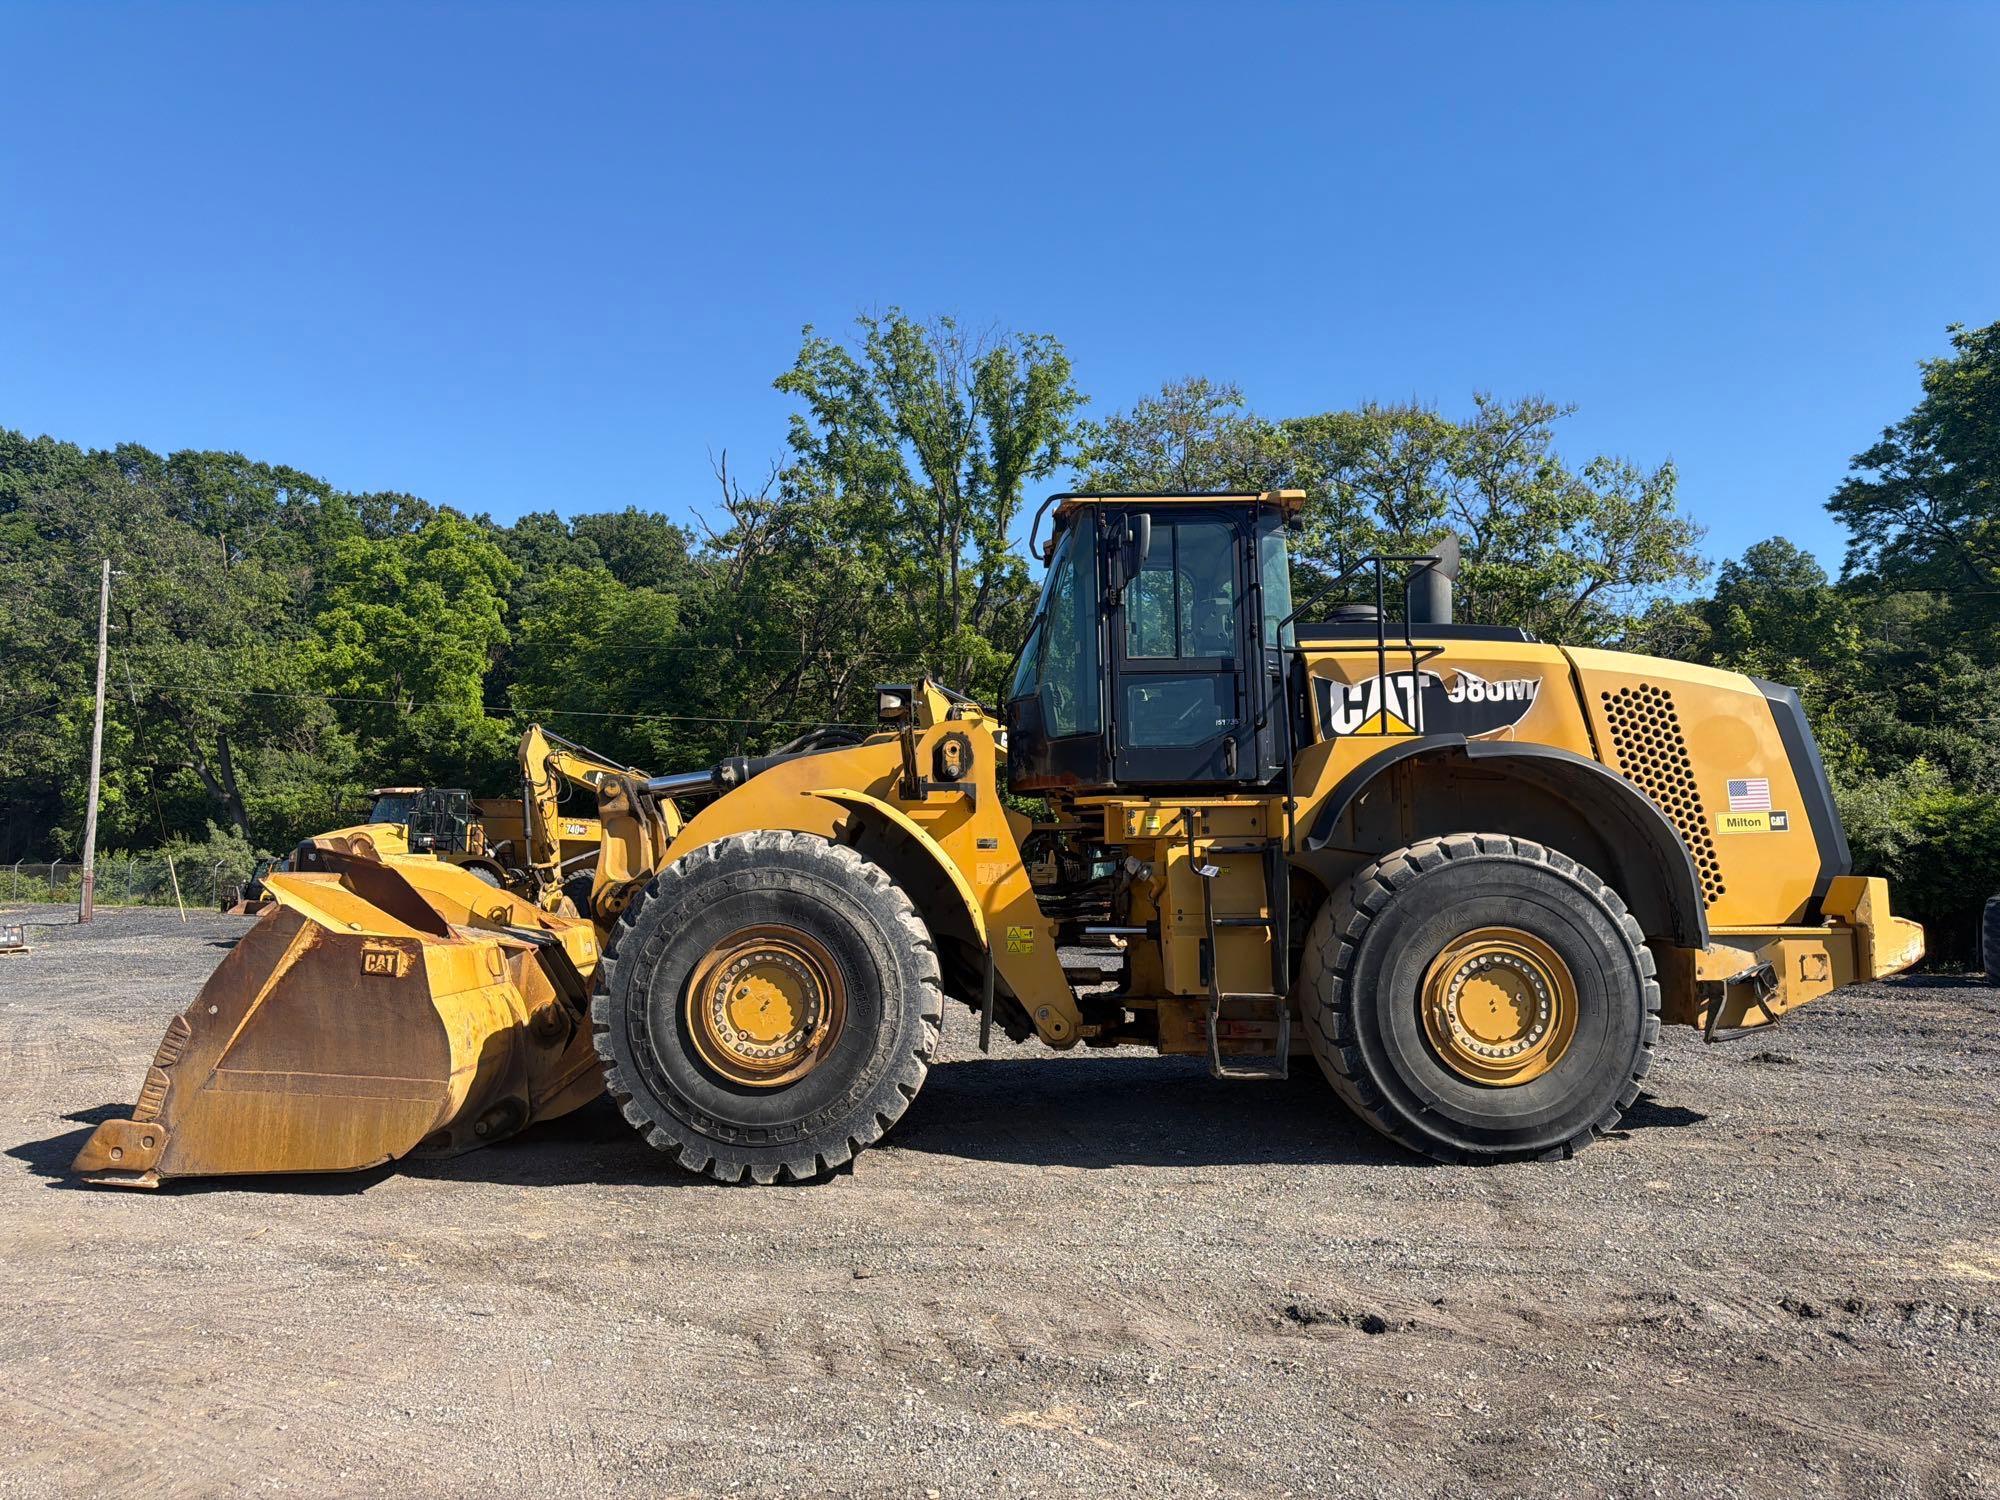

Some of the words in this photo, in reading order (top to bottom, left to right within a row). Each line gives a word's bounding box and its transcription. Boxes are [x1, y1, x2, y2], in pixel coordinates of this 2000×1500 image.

[1330, 675, 1430, 735] CAT
[566, 824, 580, 835] 740
[1726, 817, 1762, 828] Milton
[1770, 815, 1786, 826] CAT
[365, 954, 396, 973] CAT
